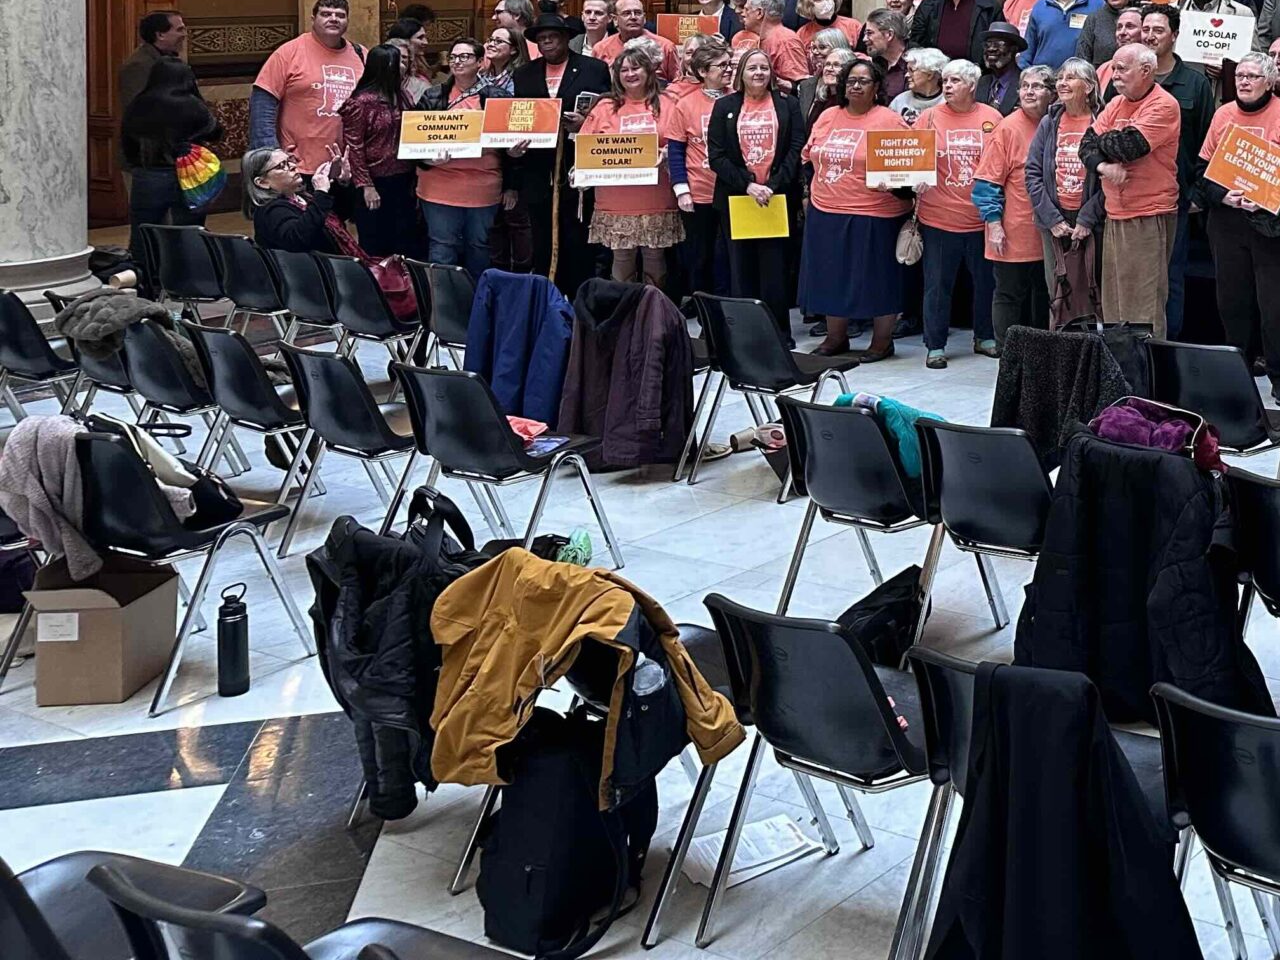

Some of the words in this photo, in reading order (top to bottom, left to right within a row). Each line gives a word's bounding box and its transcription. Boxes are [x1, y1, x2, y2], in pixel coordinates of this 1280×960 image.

[1193, 29, 1207, 38] MY
[1208, 30, 1238, 40] SOLAR
[1196, 41, 1230, 51] CO-OP!
[512, 101, 535, 110] FIGHT
[880, 138, 902, 147] FIGHT
[903, 138, 919, 146] FOR
[591, 147, 644, 155] COMMUNITY
[874, 148, 894, 157] YOUR
[895, 148, 926, 157] ENERGY
[1236, 138, 1251, 150] LET
[1251, 145, 1267, 158] THE
[884, 158, 914, 167] RIGHTS!
[1236, 148, 1253, 162] PAY
[1254, 156, 1277, 174] YOUR
[1224, 152, 1261, 176] ELECTRIC
[1260, 171, 1280, 187] BILL!
